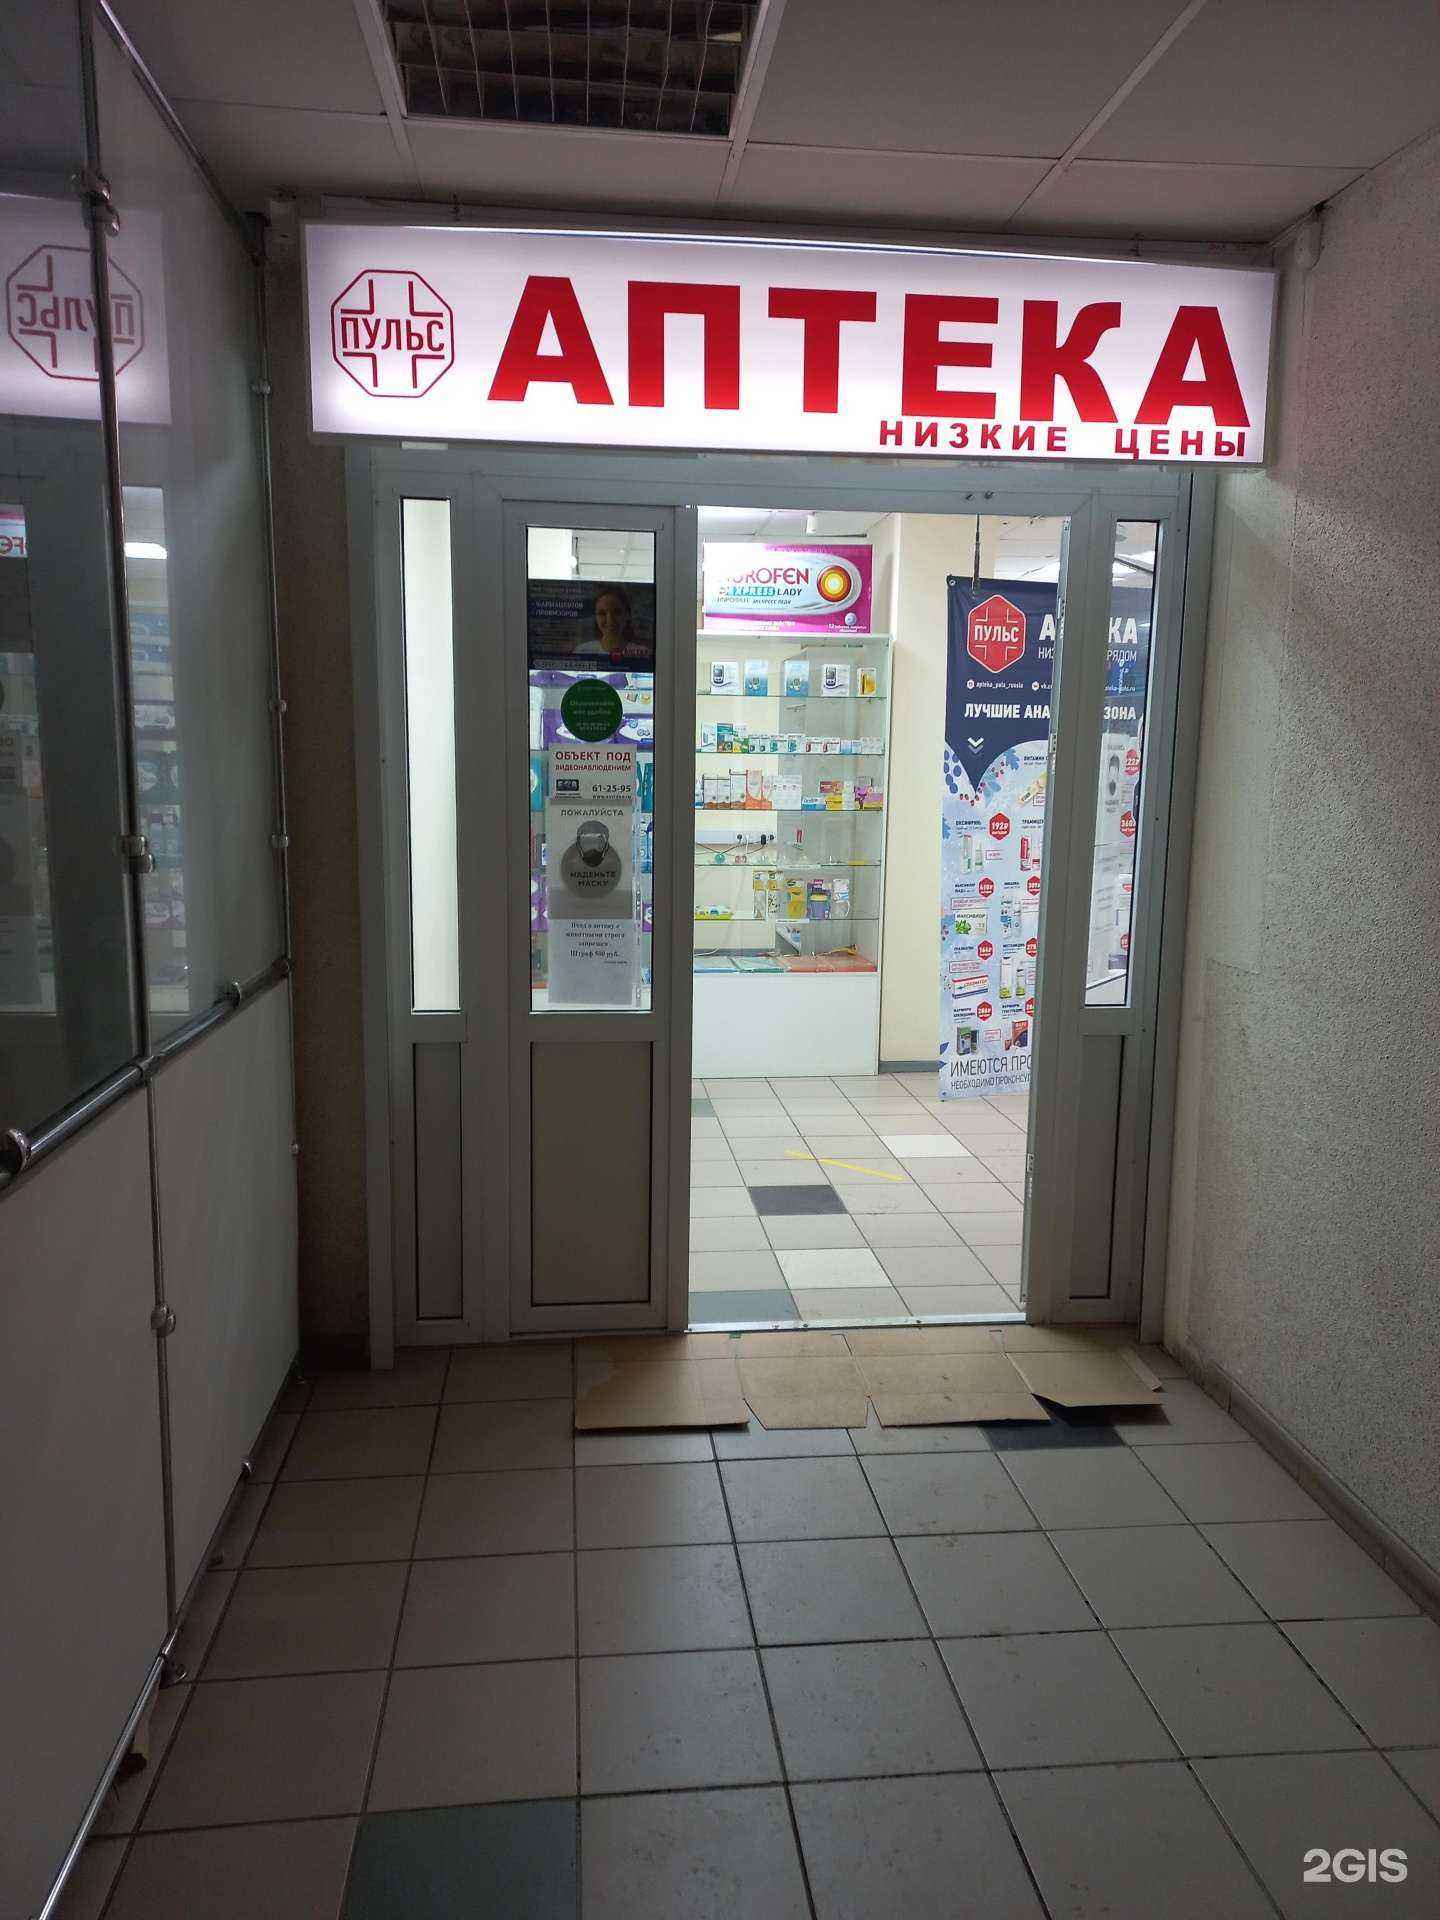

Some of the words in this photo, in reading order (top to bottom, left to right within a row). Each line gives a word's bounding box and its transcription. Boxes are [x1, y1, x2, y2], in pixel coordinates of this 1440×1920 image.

[340, 311, 445, 354] ПУЛЬС
[487, 275, 1252, 428] АПТЕКА
[878, 420, 1068, 453] НИЗКИЕ
[1114, 426, 1248, 462] ЦЕНЫ
[777, 588, 802, 596] LADY
[974, 624, 1019, 642] ПУЛЬС
[1107, 649, 1137, 662] РЯДОМ
[964, 703, 1020, 719] ЛУЧШИЕ
[1024, 704, 1050, 719] АНА
[1104, 706, 1136, 720] ЗОНА
[555, 751, 600, 761] ОБЪЕКТ
[607, 751, 631, 763] ПОД
[555, 764, 632, 772] ВИДЕОНАБЛЮДЕНИЕМ
[592, 784, 631, 793] 61-25-95
[561, 807, 624, 817] ПОЖАЛУЙСТА
[950, 1057, 1008, 1077] ИМЕЮТСЯ
[1012, 1054, 1033, 1071] ПРО
[951, 1076, 996, 1090] НЕОБХОДИМО
[996, 1073, 1031, 1086] ПРОКОНСУЛ
